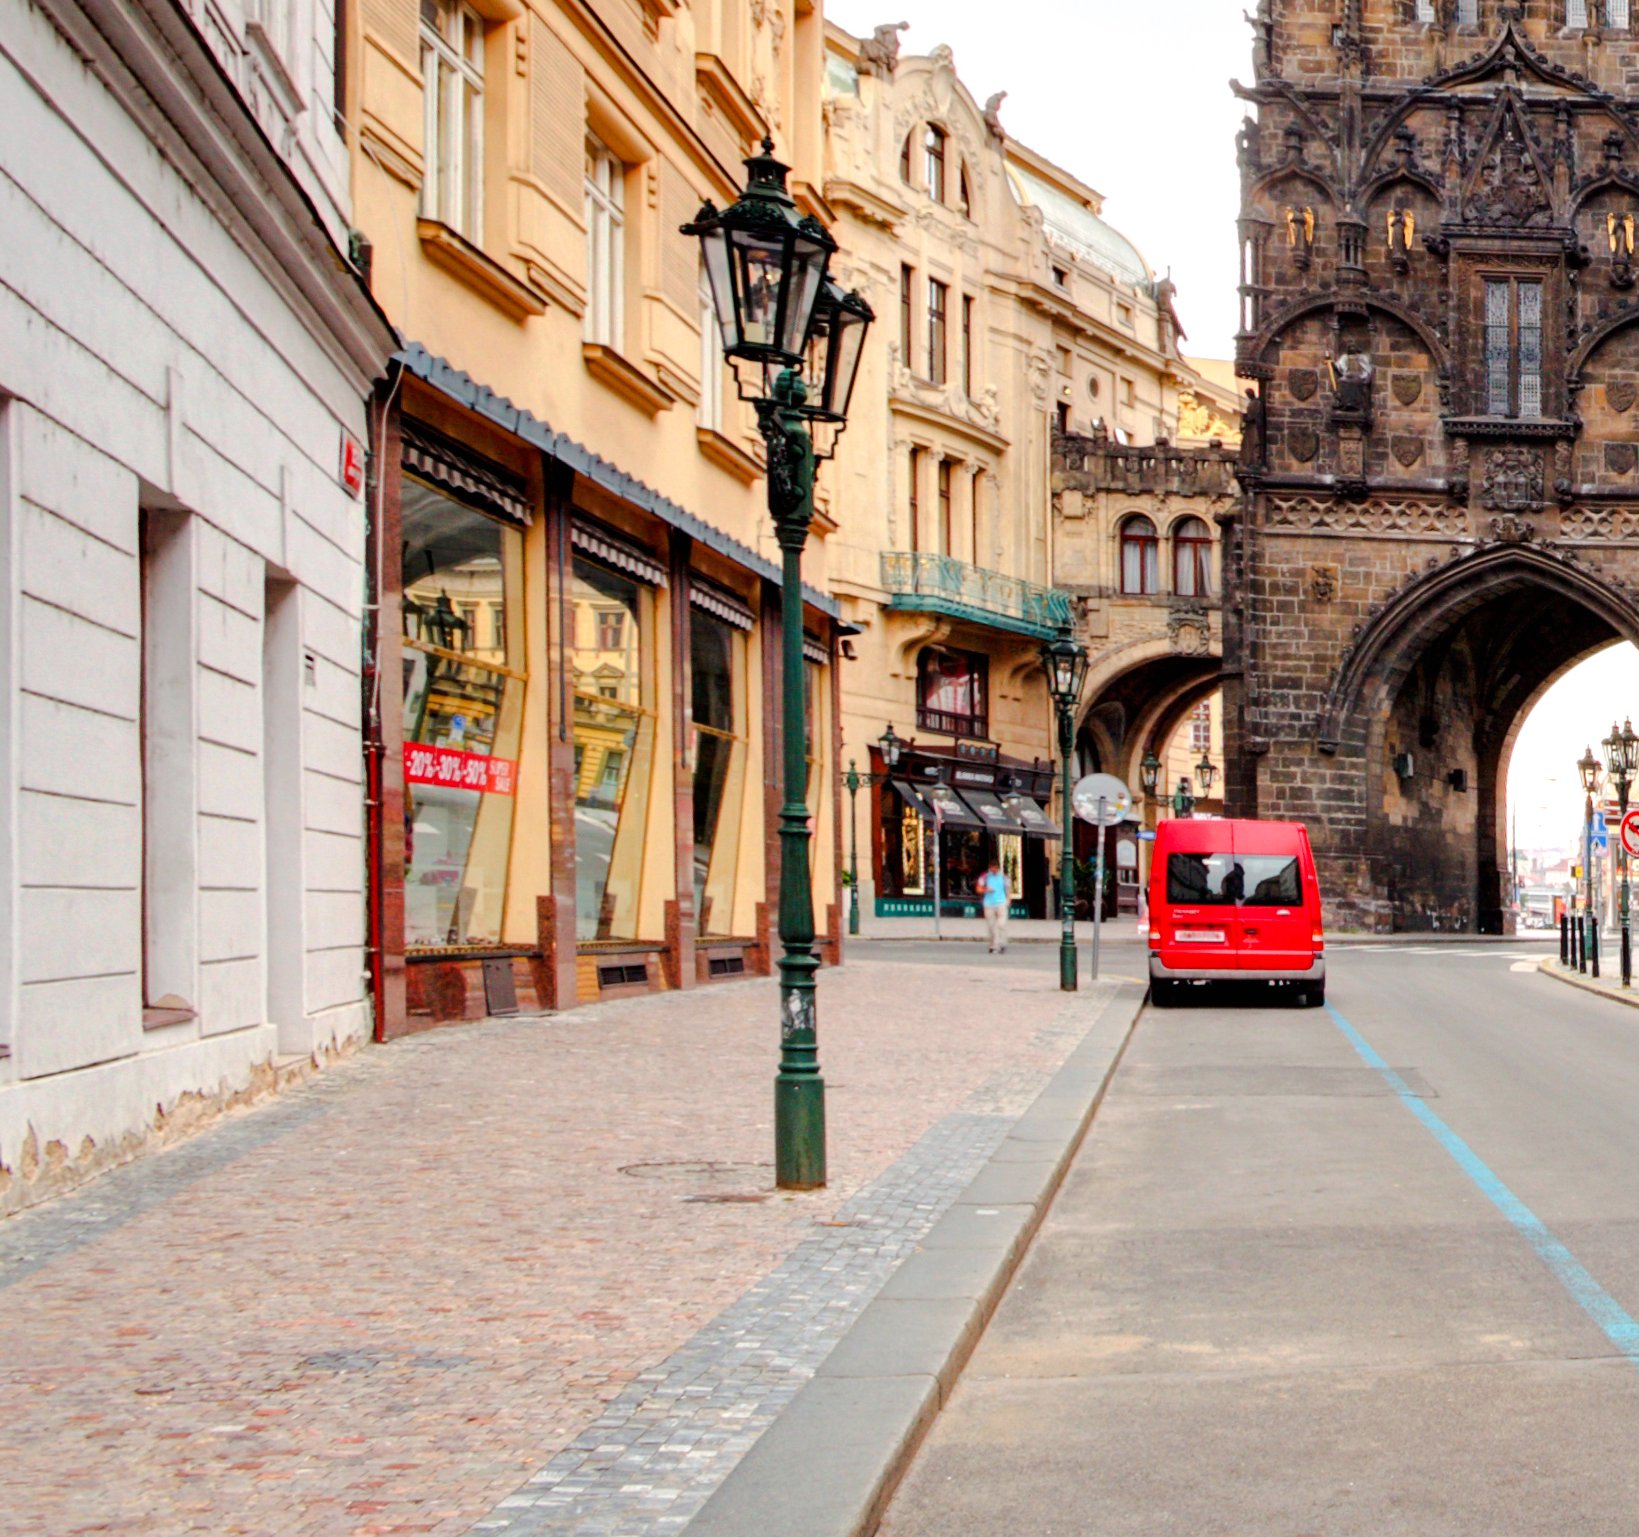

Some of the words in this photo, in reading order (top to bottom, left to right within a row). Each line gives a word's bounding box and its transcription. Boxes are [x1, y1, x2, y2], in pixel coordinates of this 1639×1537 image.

[406, 750, 434, 778] -20%
[435, 754, 462, 782] -30%
[462, 759, 487, 785] -50%
